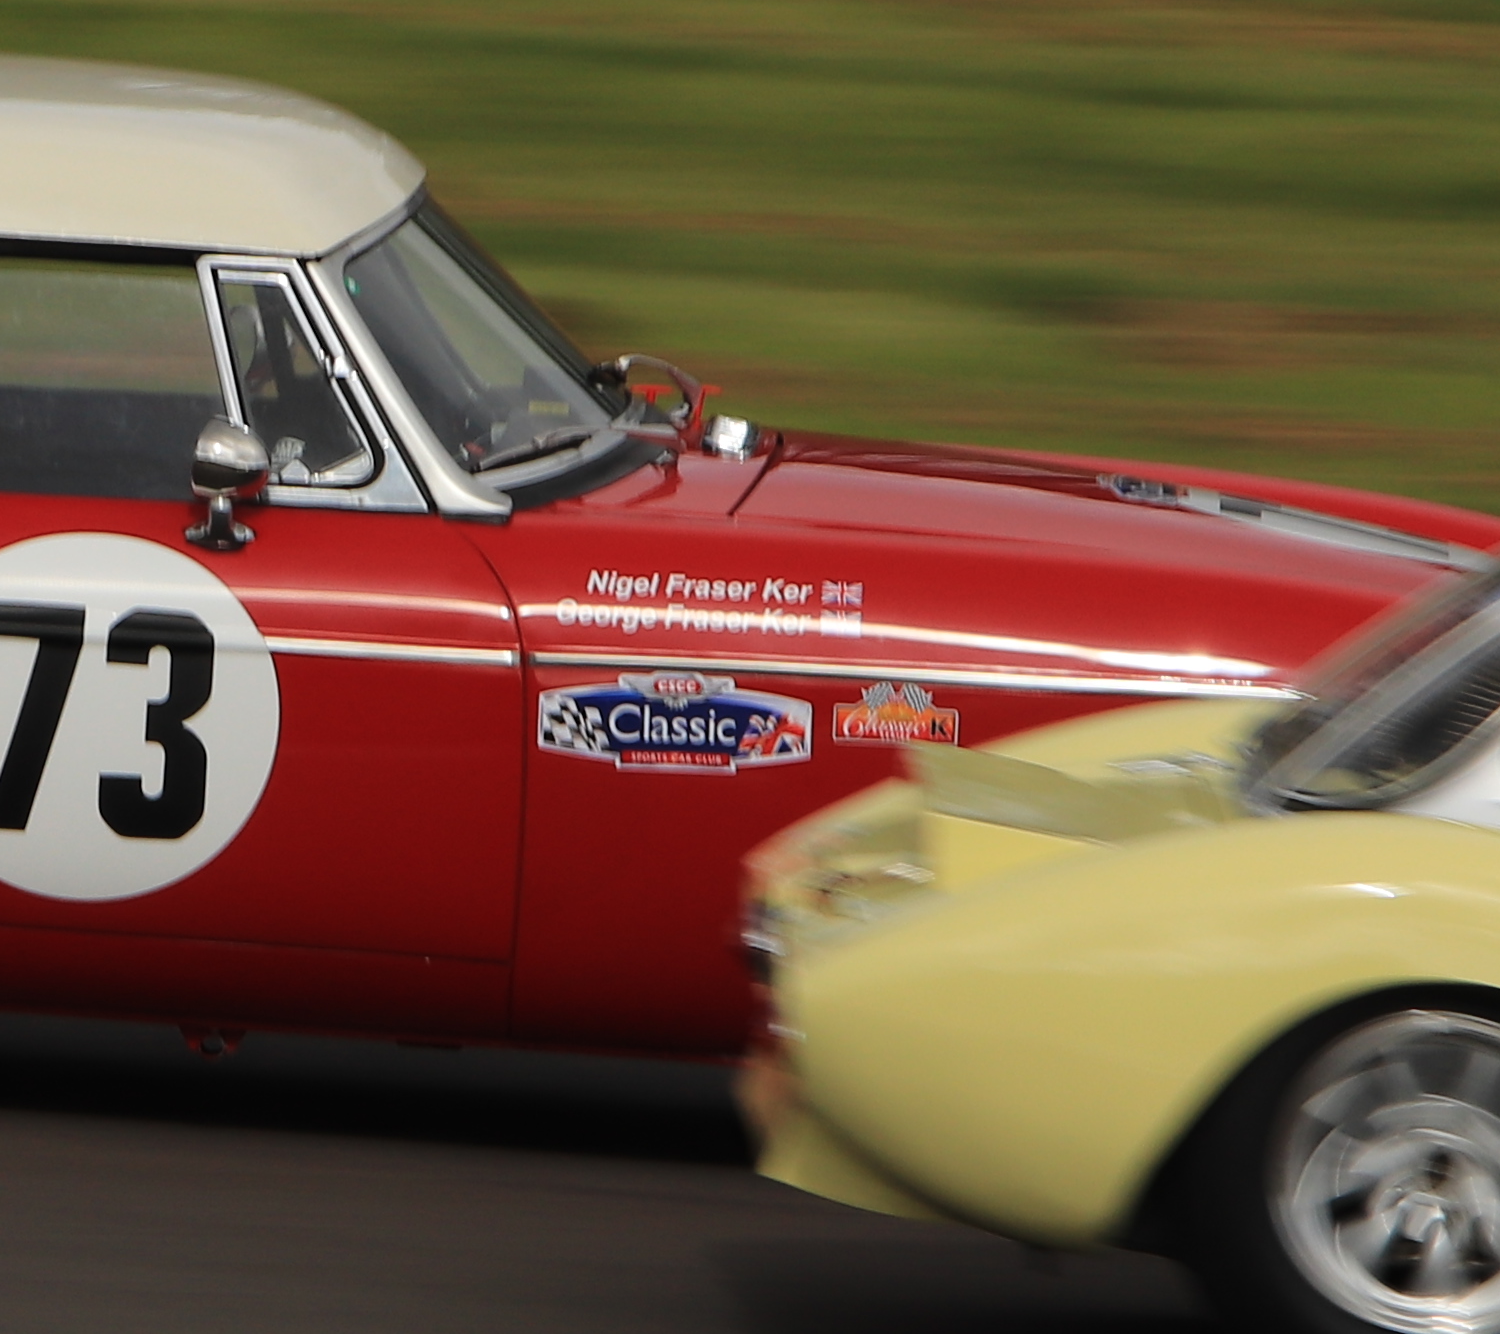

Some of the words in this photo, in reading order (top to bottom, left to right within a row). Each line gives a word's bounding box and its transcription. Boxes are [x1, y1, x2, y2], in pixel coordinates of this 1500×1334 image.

[587, 569, 660, 602] Nigel
[665, 572, 757, 603] Fraser
[761, 576, 815, 605] Ker
[556, 597, 657, 635] George
[664, 602, 754, 633] Fraser
[760, 606, 812, 636] Ker
[608, 702, 737, 747] Classic
[930, 716, 951, 738] K
[630, 751, 668, 763] SPORTS
